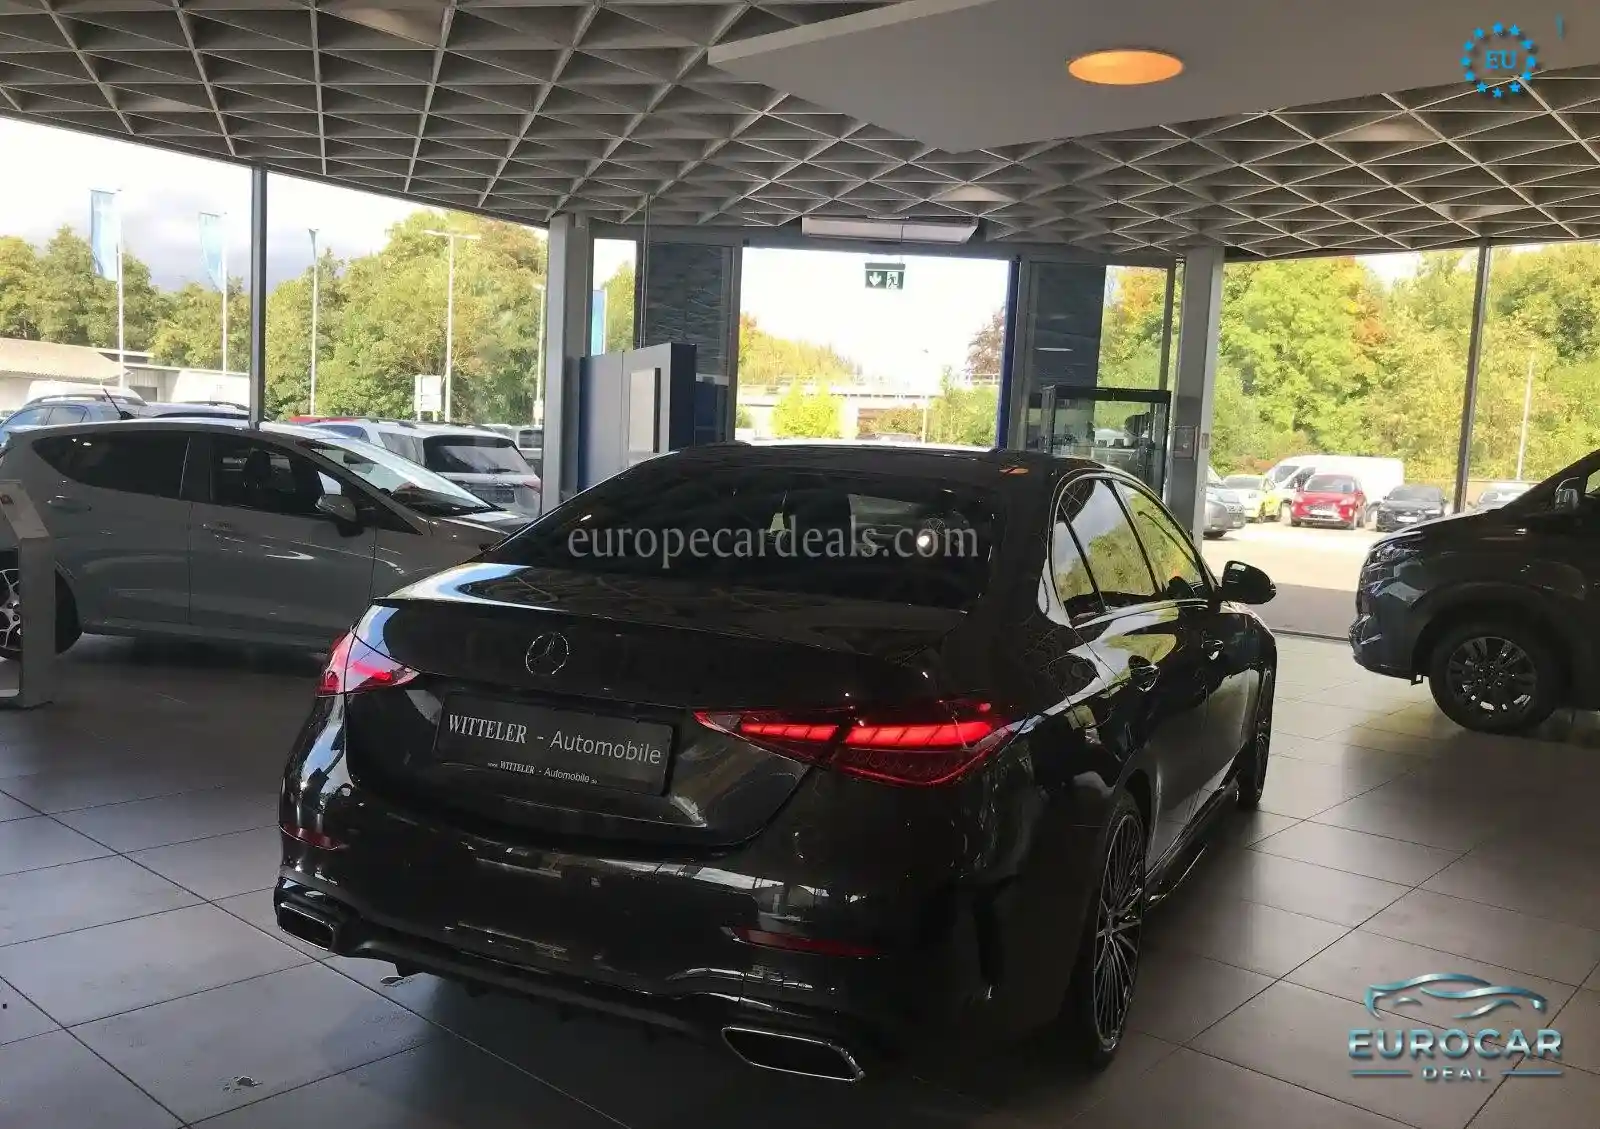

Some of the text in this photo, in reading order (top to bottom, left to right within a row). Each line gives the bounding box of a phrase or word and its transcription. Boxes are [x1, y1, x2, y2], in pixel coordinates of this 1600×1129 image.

[448, 714, 527, 744] WITTELER
[549, 730, 662, 764] Automobile
[500, 760, 535, 775] WITTELER
[544, 767, 590, 784] Automobile
